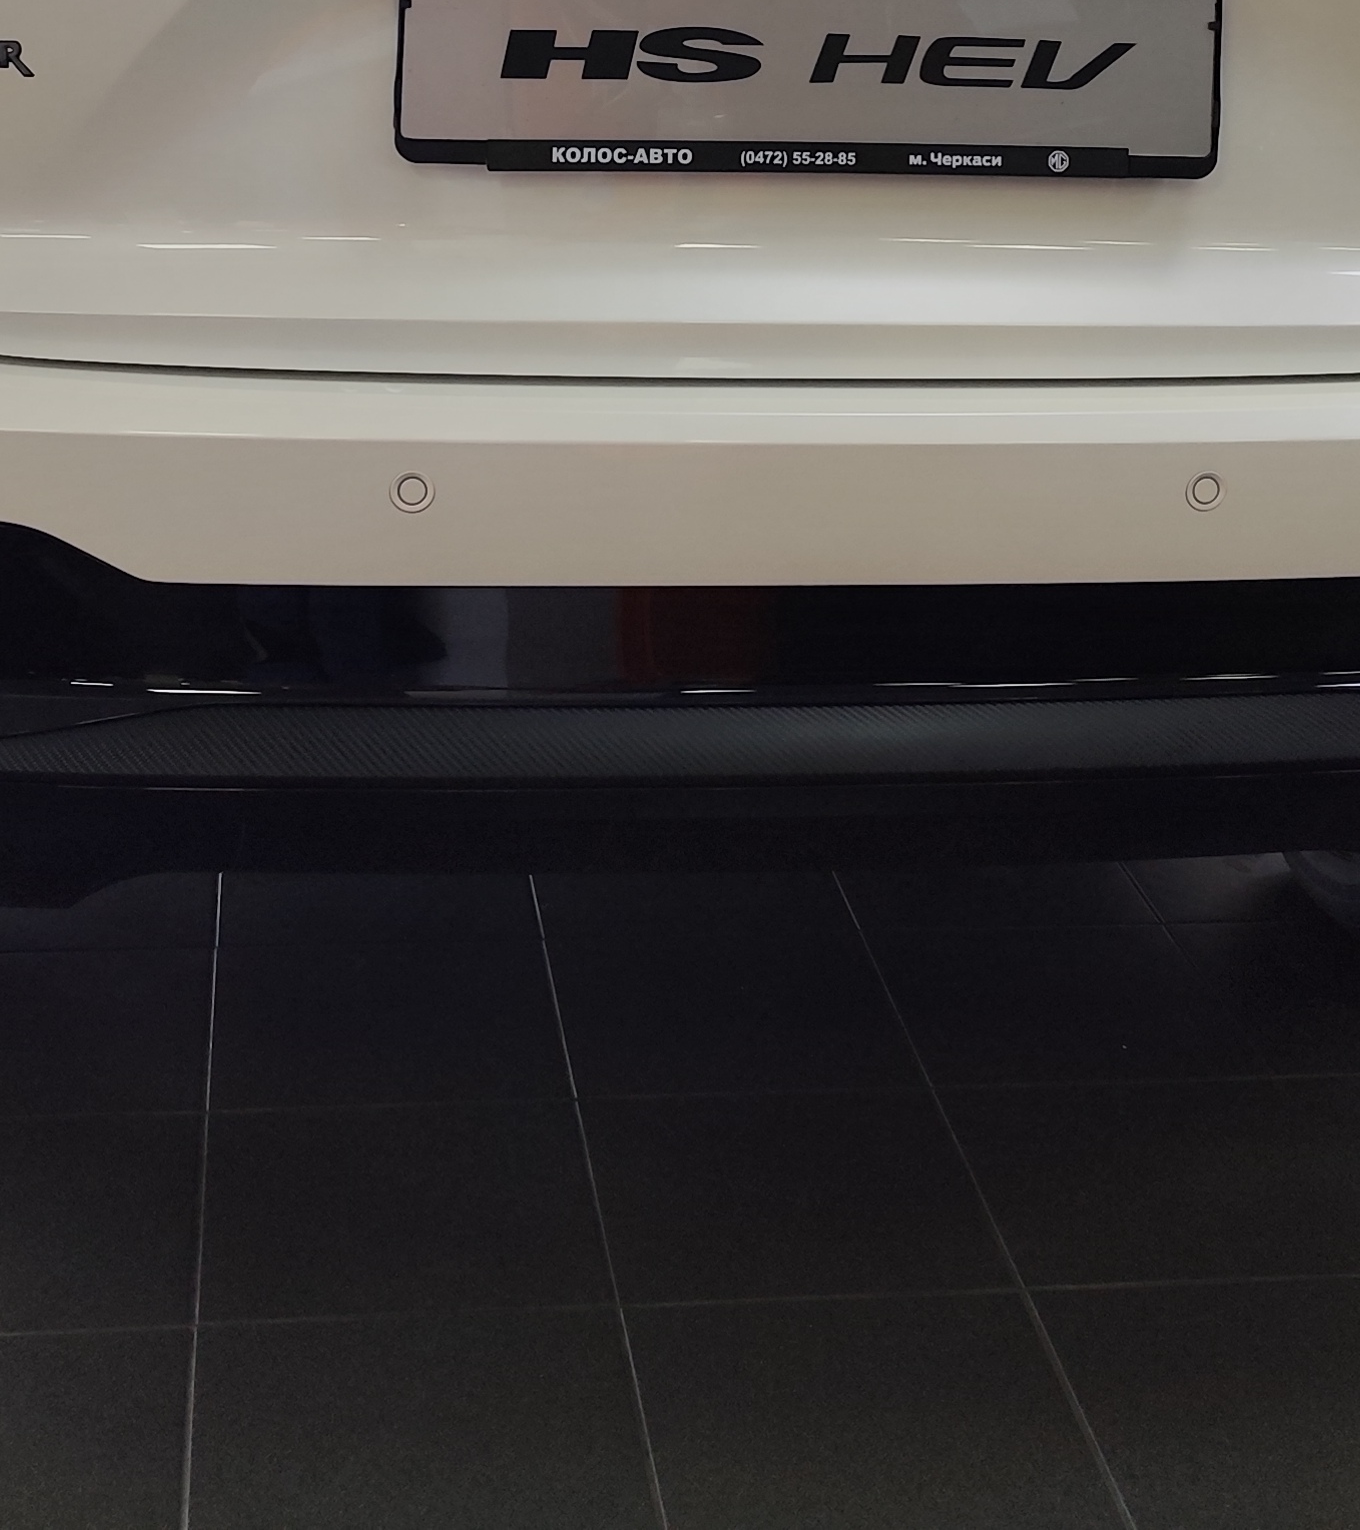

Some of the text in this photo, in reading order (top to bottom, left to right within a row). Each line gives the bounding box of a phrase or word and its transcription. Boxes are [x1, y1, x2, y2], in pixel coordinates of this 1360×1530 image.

[500, 26, 1137, 90] HS HEV
[551, 145, 1002, 169] КОЛОС-АВТО (0472) 55-28-85 м. Черкаси
